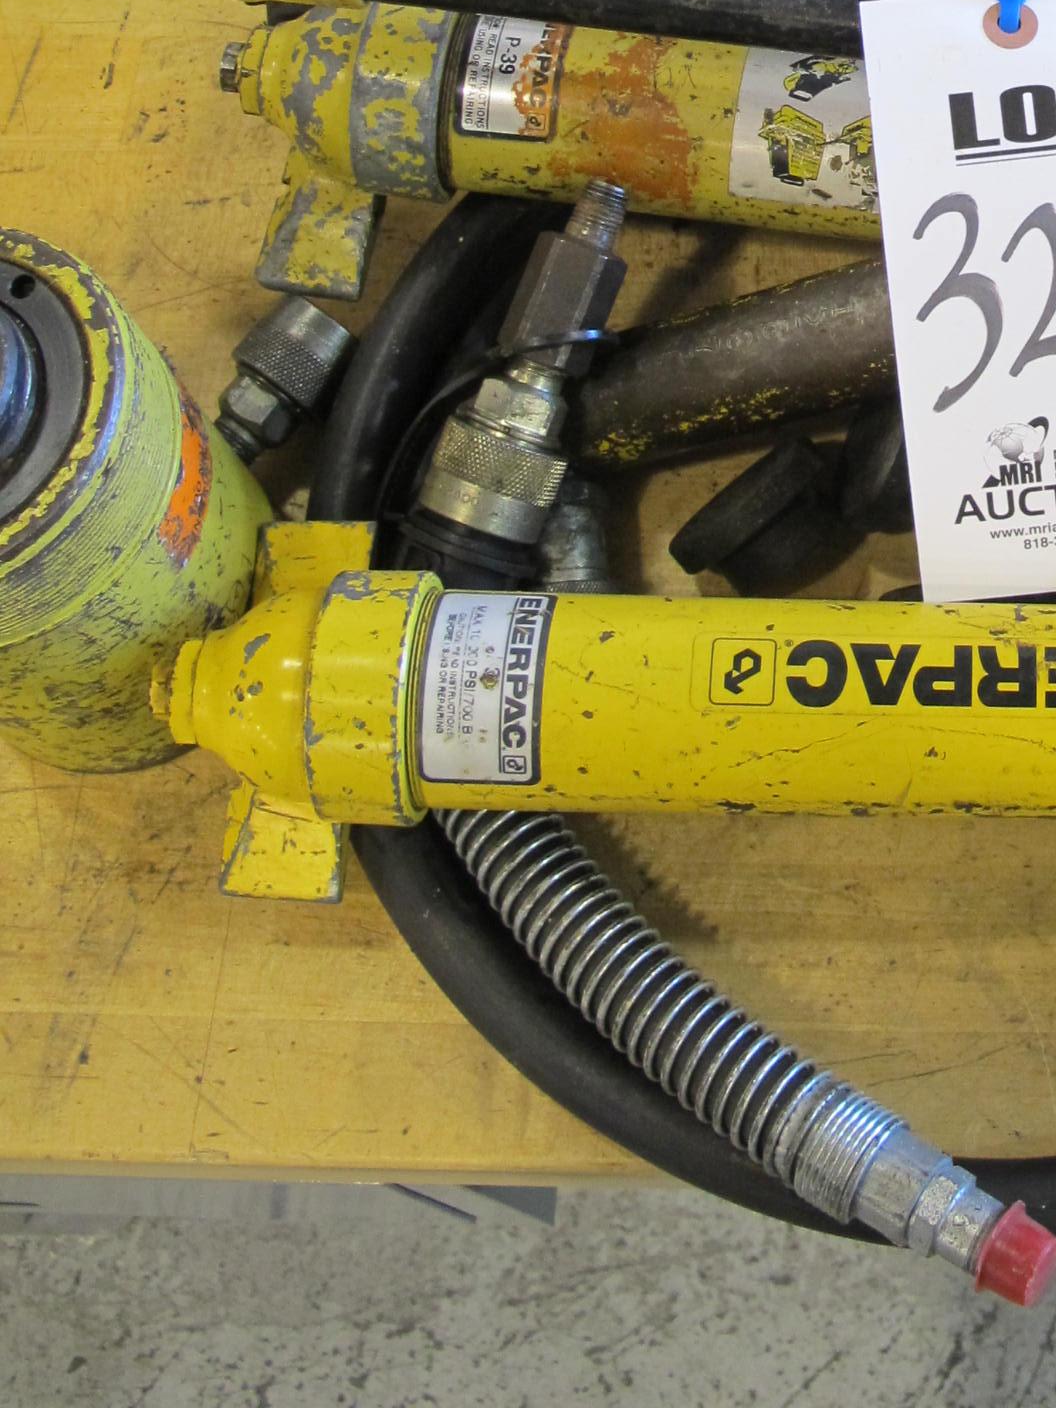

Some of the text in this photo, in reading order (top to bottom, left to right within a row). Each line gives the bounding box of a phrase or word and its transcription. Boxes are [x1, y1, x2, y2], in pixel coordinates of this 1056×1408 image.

[473, 29, 484, 52] USING
[485, 33, 498, 56] READ
[499, 36, 522, 75] P-39
[476, 56, 492, 129] INSTRUCTIONS
[999, 460, 1043, 486] MRI
[502, 597, 543, 749] ENERPAC
